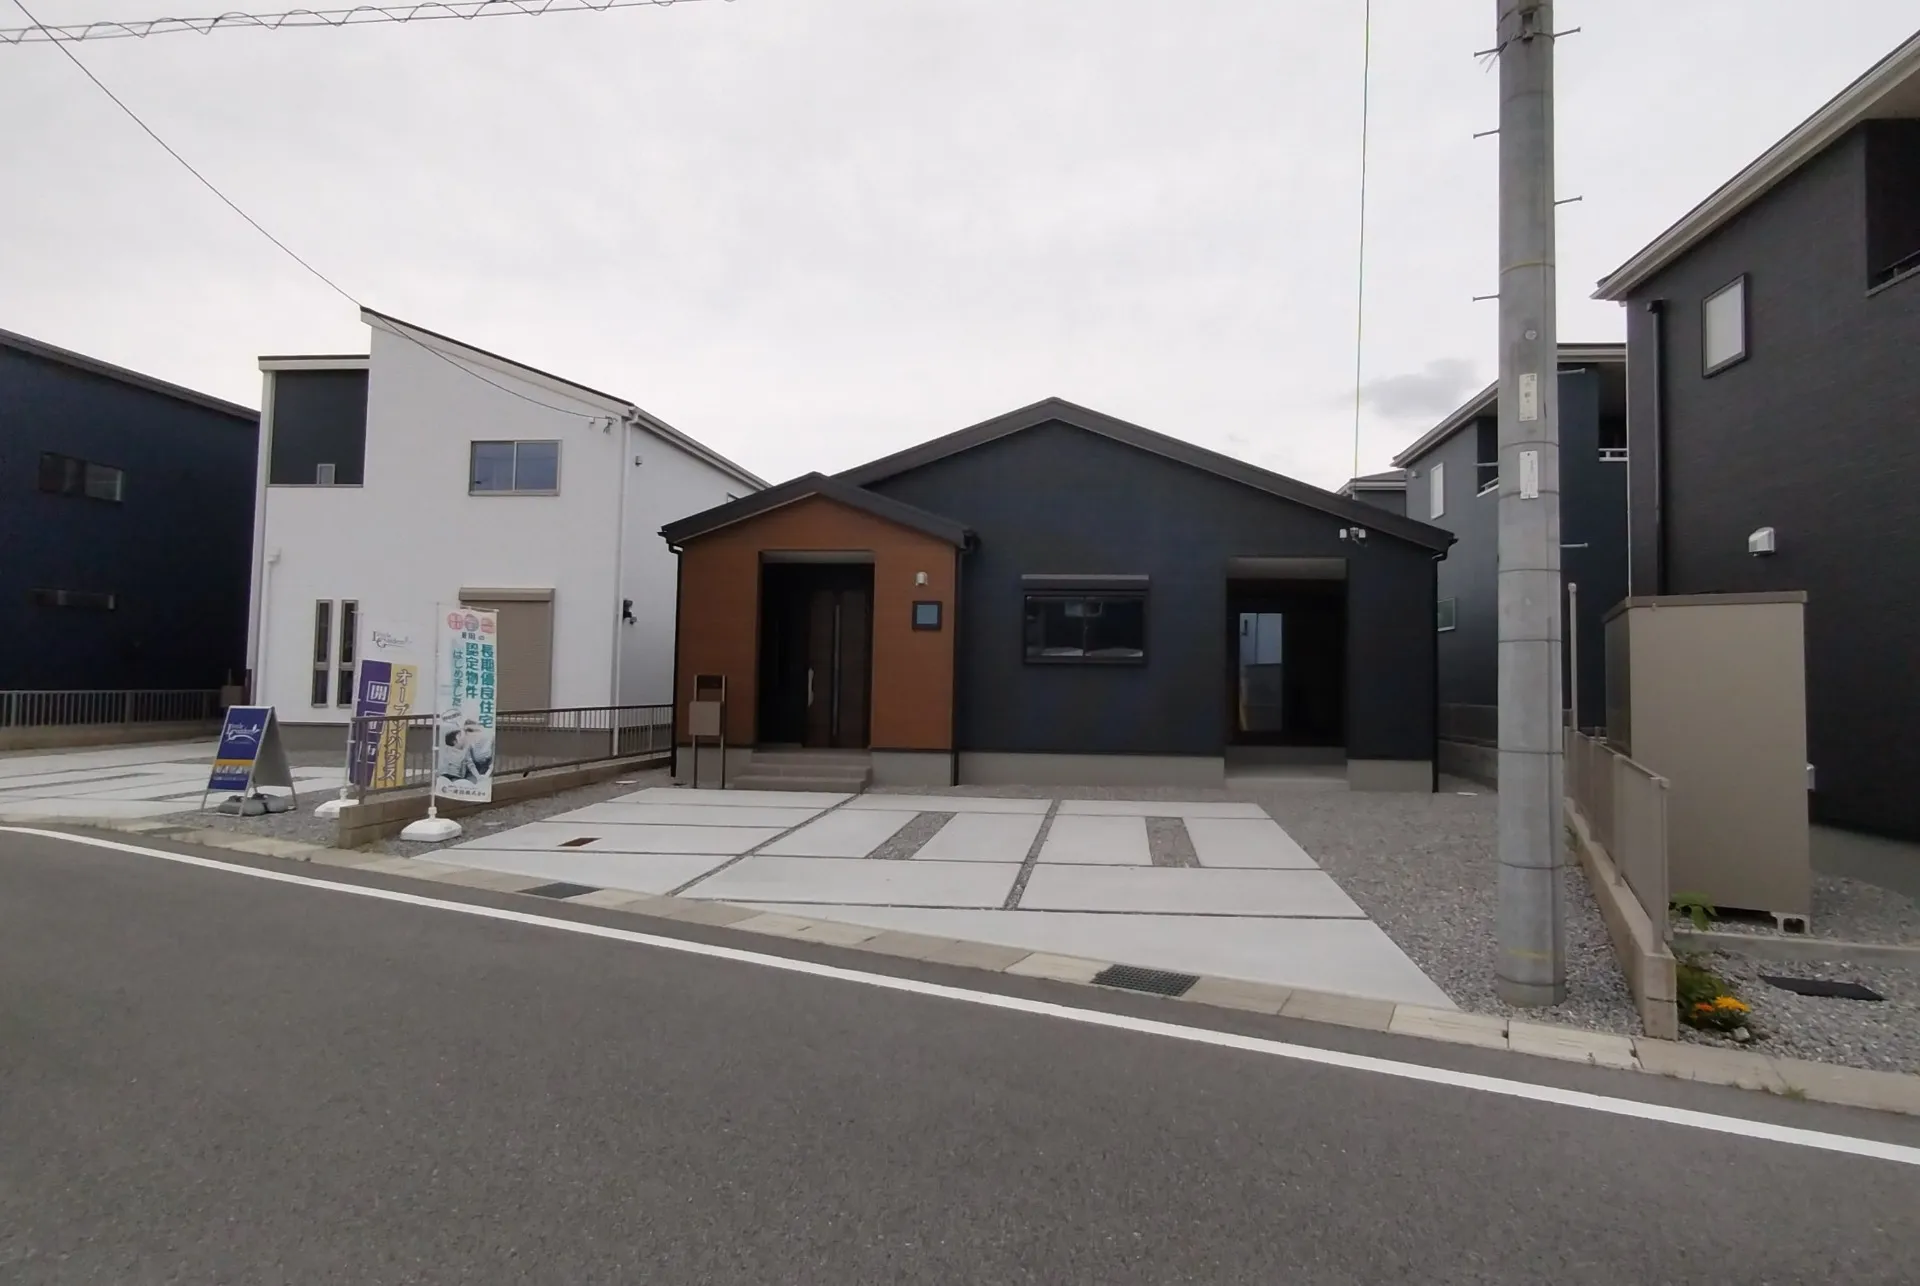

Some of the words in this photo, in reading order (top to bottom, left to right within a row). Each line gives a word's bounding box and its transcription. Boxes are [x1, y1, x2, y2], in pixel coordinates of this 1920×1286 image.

[465, 642, 479, 699] 認定物件
[479, 643, 495, 729] 長期優良住宅
[378, 668, 413, 781] オープンハウス
